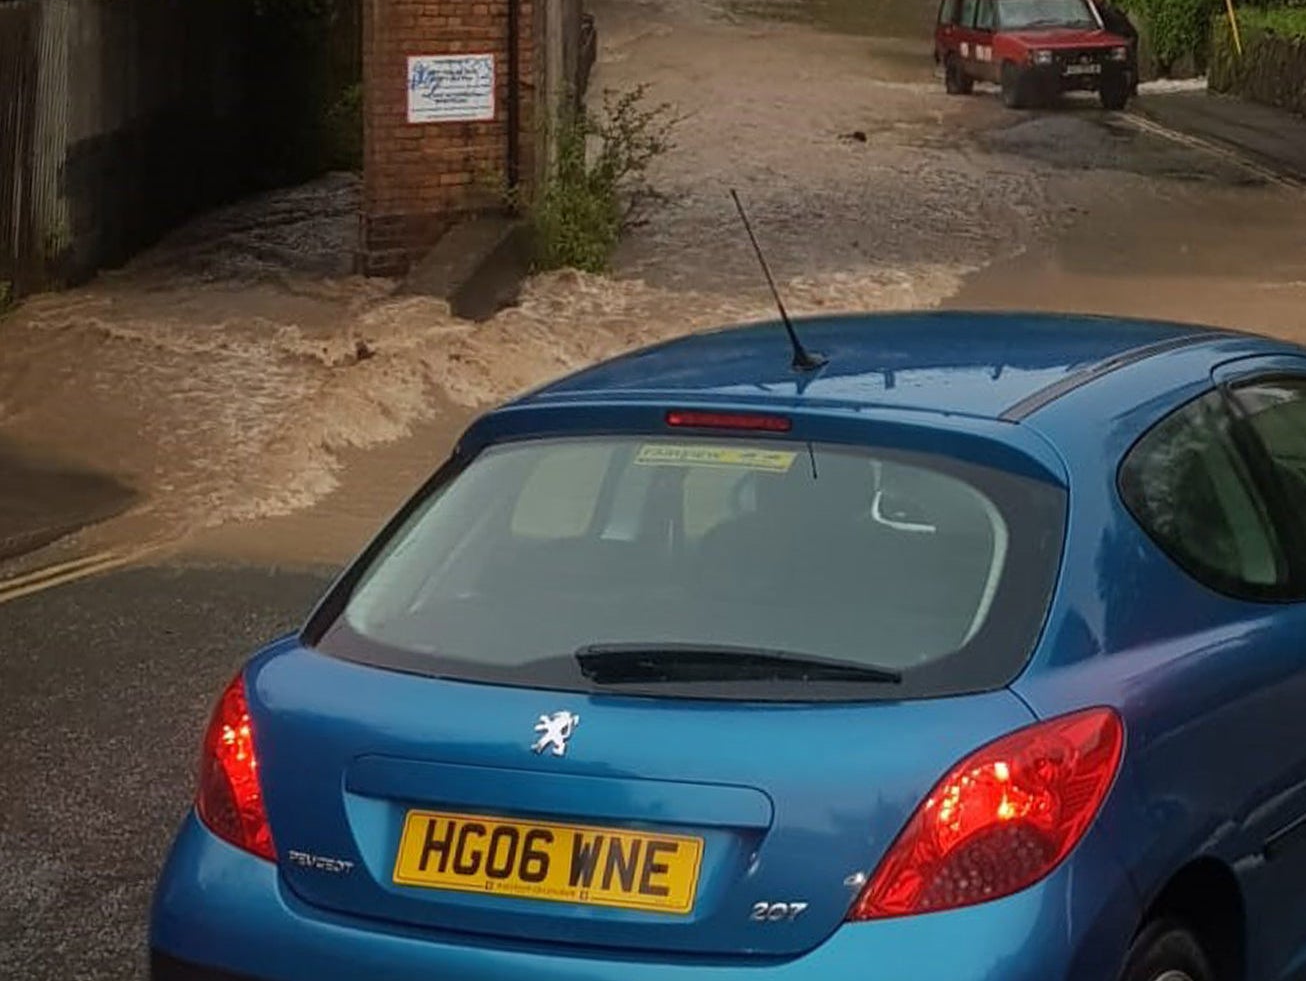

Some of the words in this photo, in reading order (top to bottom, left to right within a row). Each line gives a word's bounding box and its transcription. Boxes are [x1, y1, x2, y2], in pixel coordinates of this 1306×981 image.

[417, 818, 555, 884] HG06
[567, 832, 680, 898] WNE
[750, 901, 809, 921] 207
